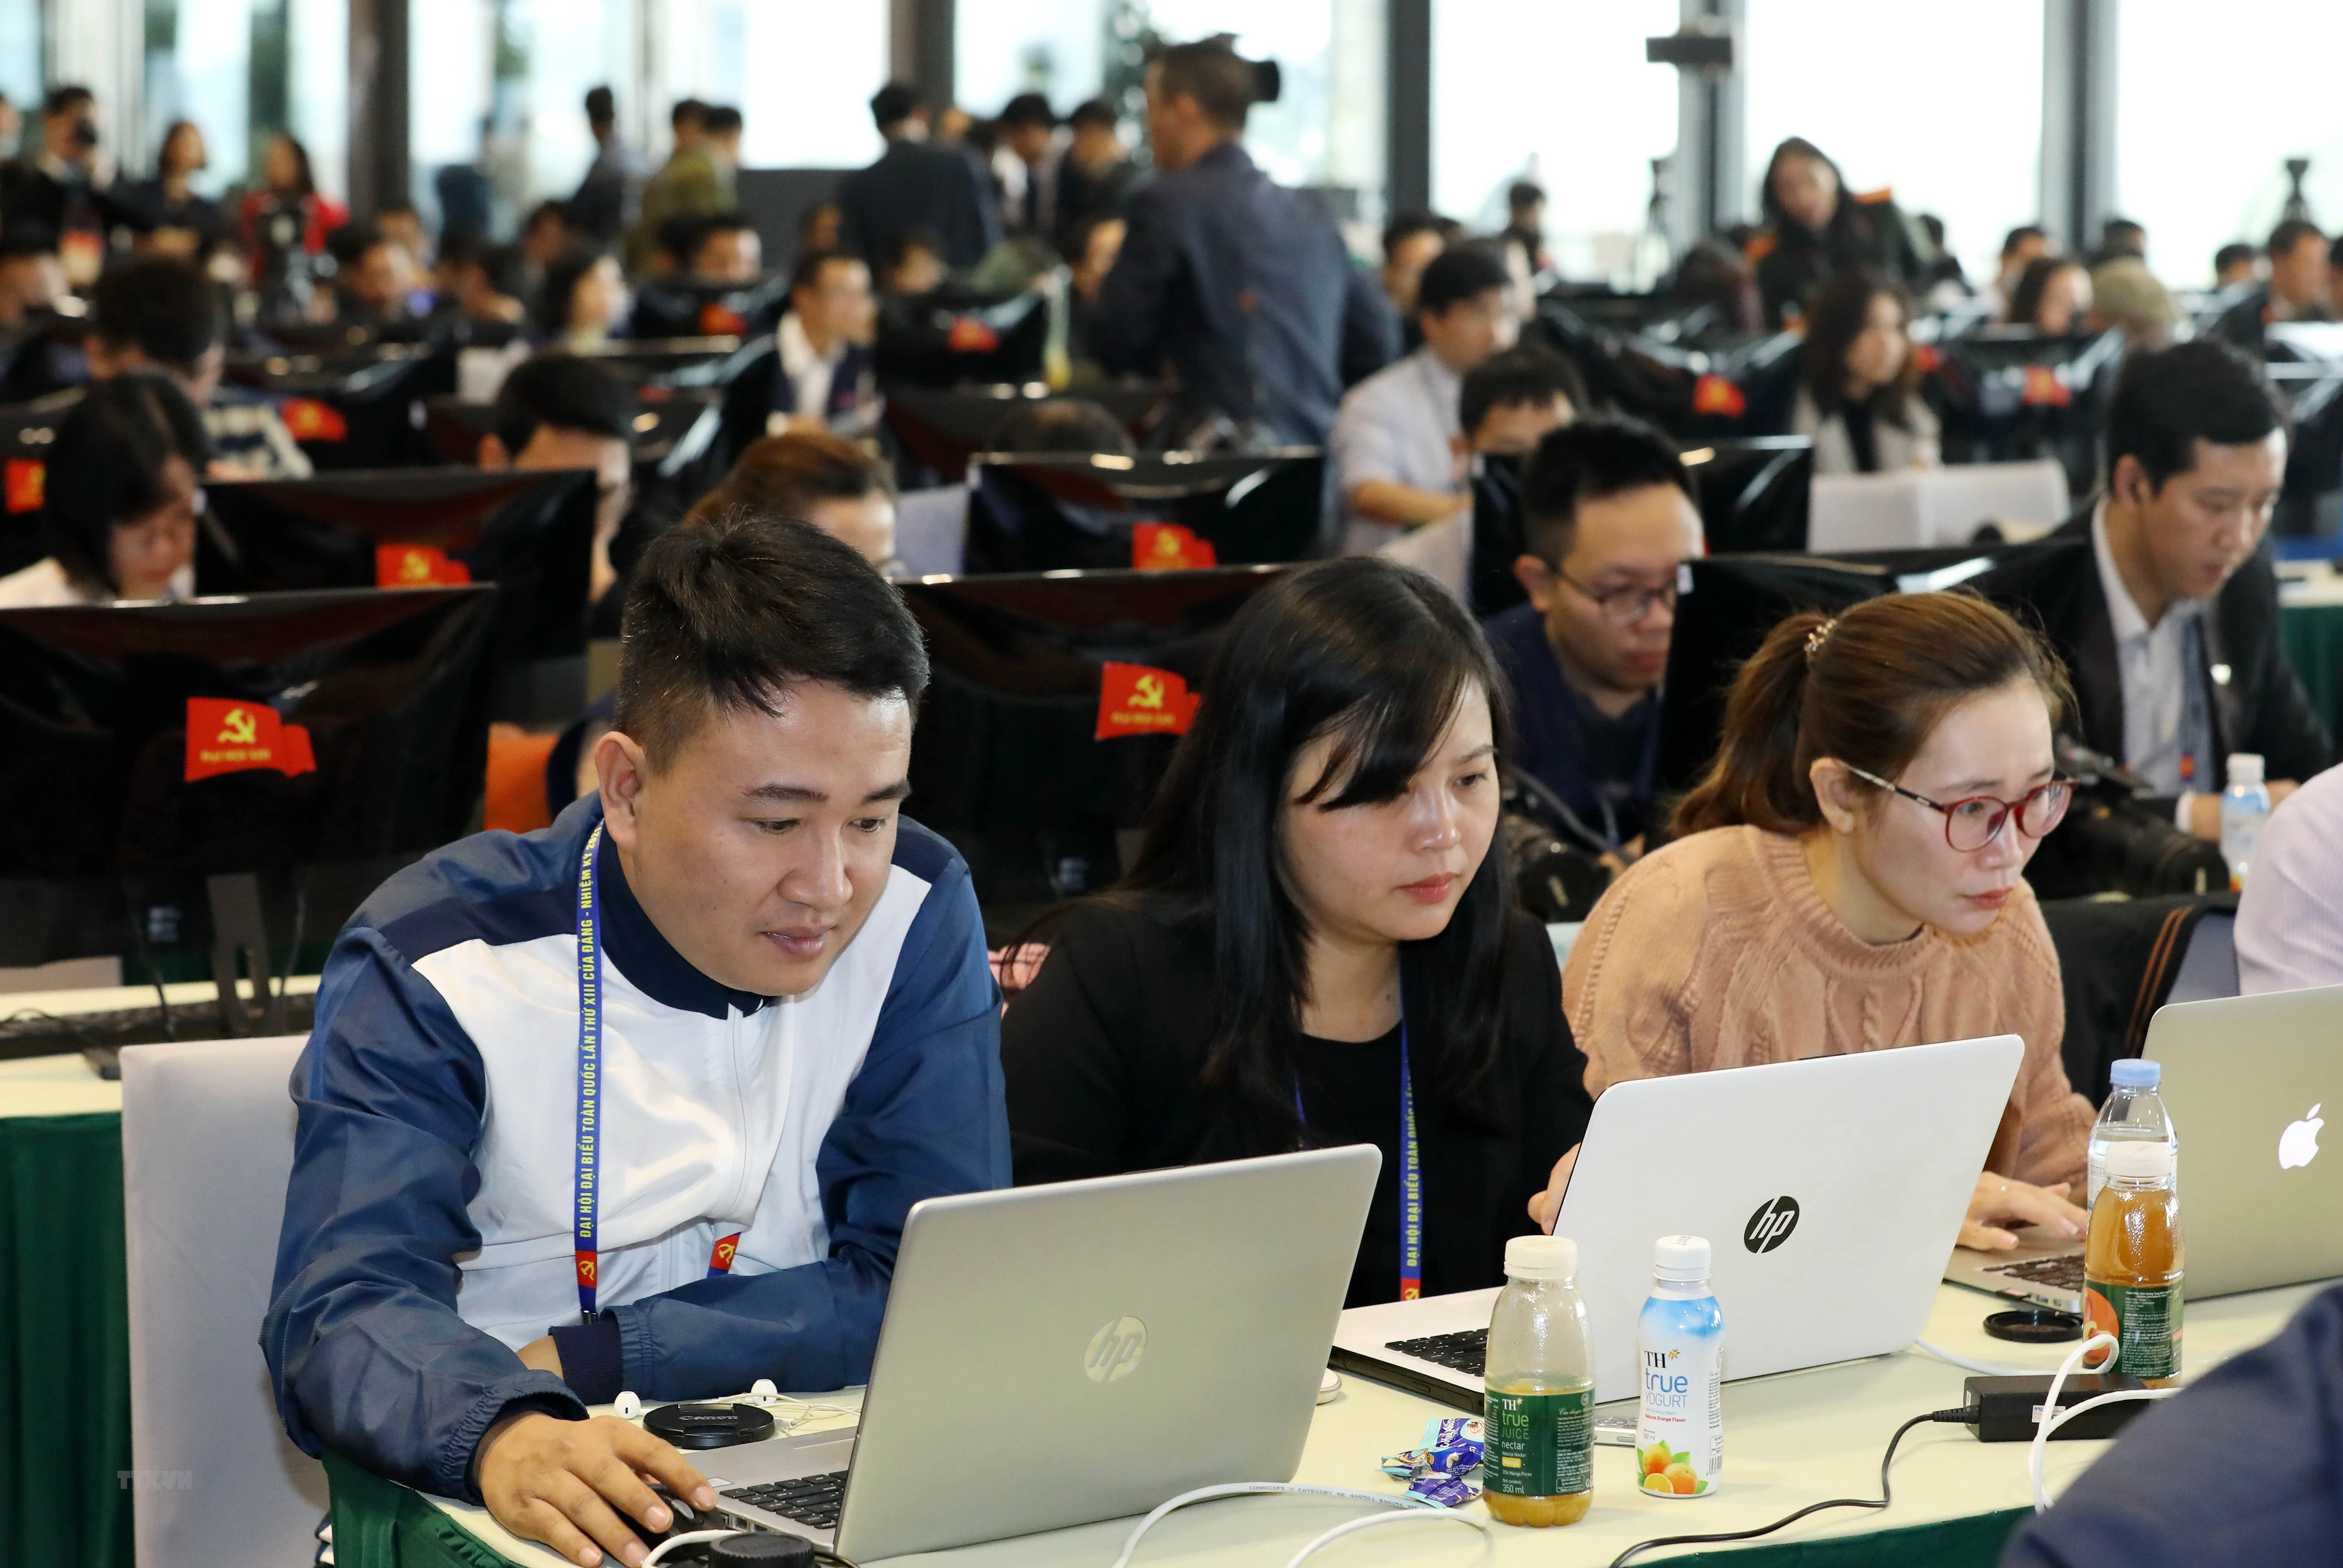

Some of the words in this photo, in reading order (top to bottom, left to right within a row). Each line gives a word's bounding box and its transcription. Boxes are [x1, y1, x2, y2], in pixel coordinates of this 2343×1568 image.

[586, 827, 602, 850] 2021
[579, 869, 593, 909] NHIỆM
[577, 919, 594, 952] ĐẢNG
[578, 957, 594, 980] CỦA
[584, 984, 595, 1005] XIII
[582, 1008, 595, 1031] THỨ
[580, 1035, 596, 1059] LẦN
[580, 1063, 596, 1096] QUỐC
[580, 1100, 595, 1132] TOÀN
[577, 1136, 594, 1164] BIỂU
[1406, 1141, 1418, 1170] TOÀN
[580, 1168, 595, 1189] ĐẠI
[1403, 1173, 1419, 1199] BIỂU
[578, 1193, 594, 1213] HỘI
[1407, 1203, 1421, 1222] ĐẠI
[580, 1217, 594, 1237] ĐẠI
[1405, 1225, 1421, 1244] HỘI
[1749, 1196, 1795, 1254] hp
[1406, 1247, 1420, 1267] ĐẠI
[1088, 1316, 1143, 1382] hp
[1645, 1350, 1667, 1368] TH
[1645, 1368, 1688, 1393] true
[1502, 1399, 1517, 1411] TH
[1645, 1391, 1688, 1408] YOGURT
[1502, 1410, 1529, 1427] true
[1502, 1427, 1529, 1439] JUICE
[1502, 1442, 1525, 1450] nectar
[1503, 1484, 1514, 1493] 350
[1515, 1486, 1524, 1494] ml
